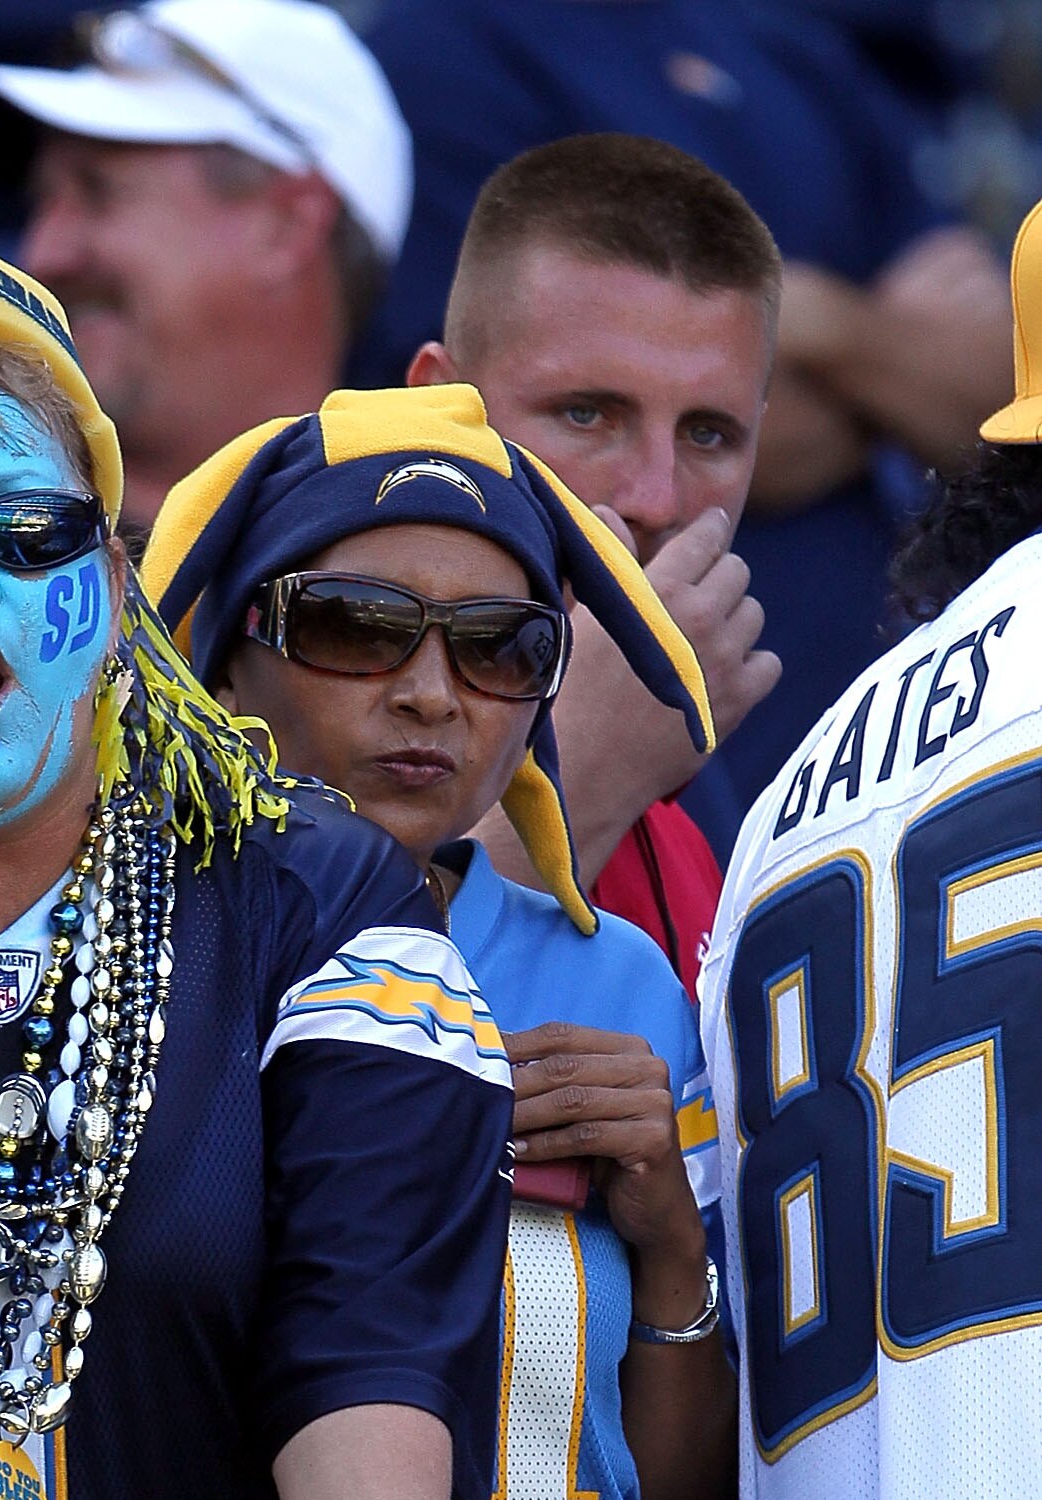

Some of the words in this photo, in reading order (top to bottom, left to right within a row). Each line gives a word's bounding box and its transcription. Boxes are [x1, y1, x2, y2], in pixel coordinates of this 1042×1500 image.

[39, 562, 101, 664] SD
[772, 606, 1016, 840] GATES
[727, 748, 1042, 1465] 85
[16, 1469, 40, 1494] YOU
